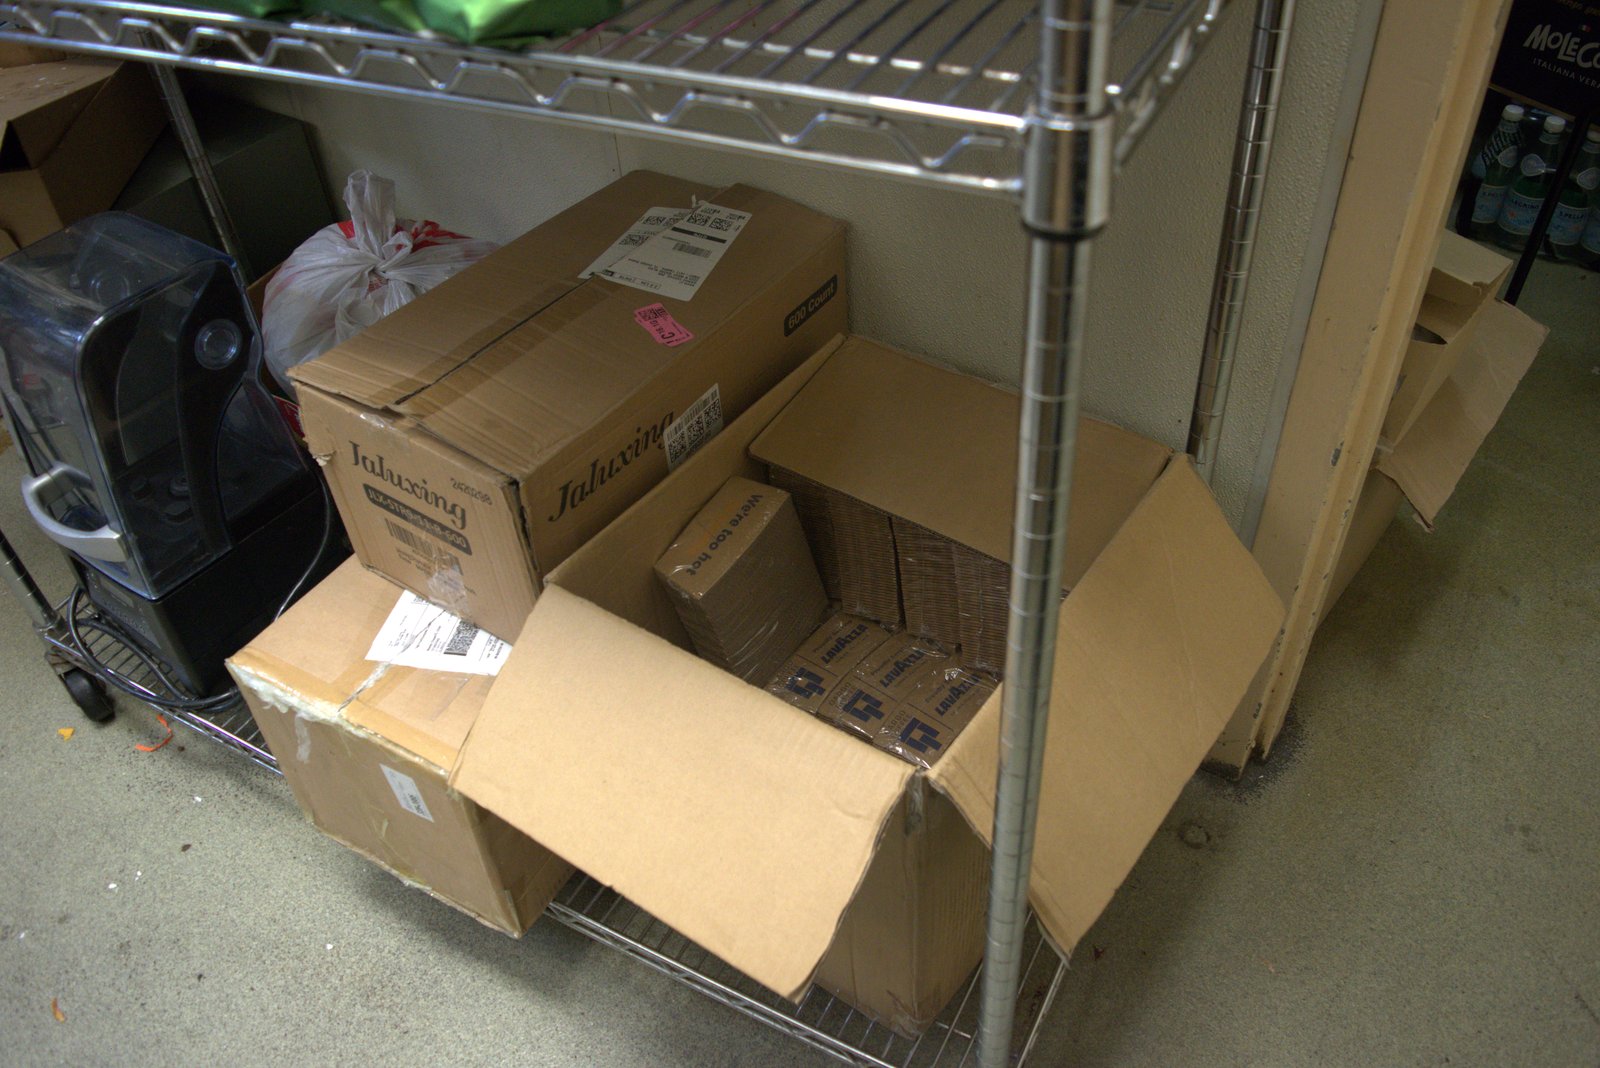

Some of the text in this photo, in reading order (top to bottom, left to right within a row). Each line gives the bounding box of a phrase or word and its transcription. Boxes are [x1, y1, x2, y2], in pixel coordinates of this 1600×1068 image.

[1533, 57, 1575, 80] ITALIANA
[788, 282, 834, 329] 600 Count
[348, 440, 467, 530] Jaluxing
[548, 411, 674, 522] Jaluxing
[686, 494, 763, 576] We're too hot
[820, 623, 869, 664] LAVAZZA
